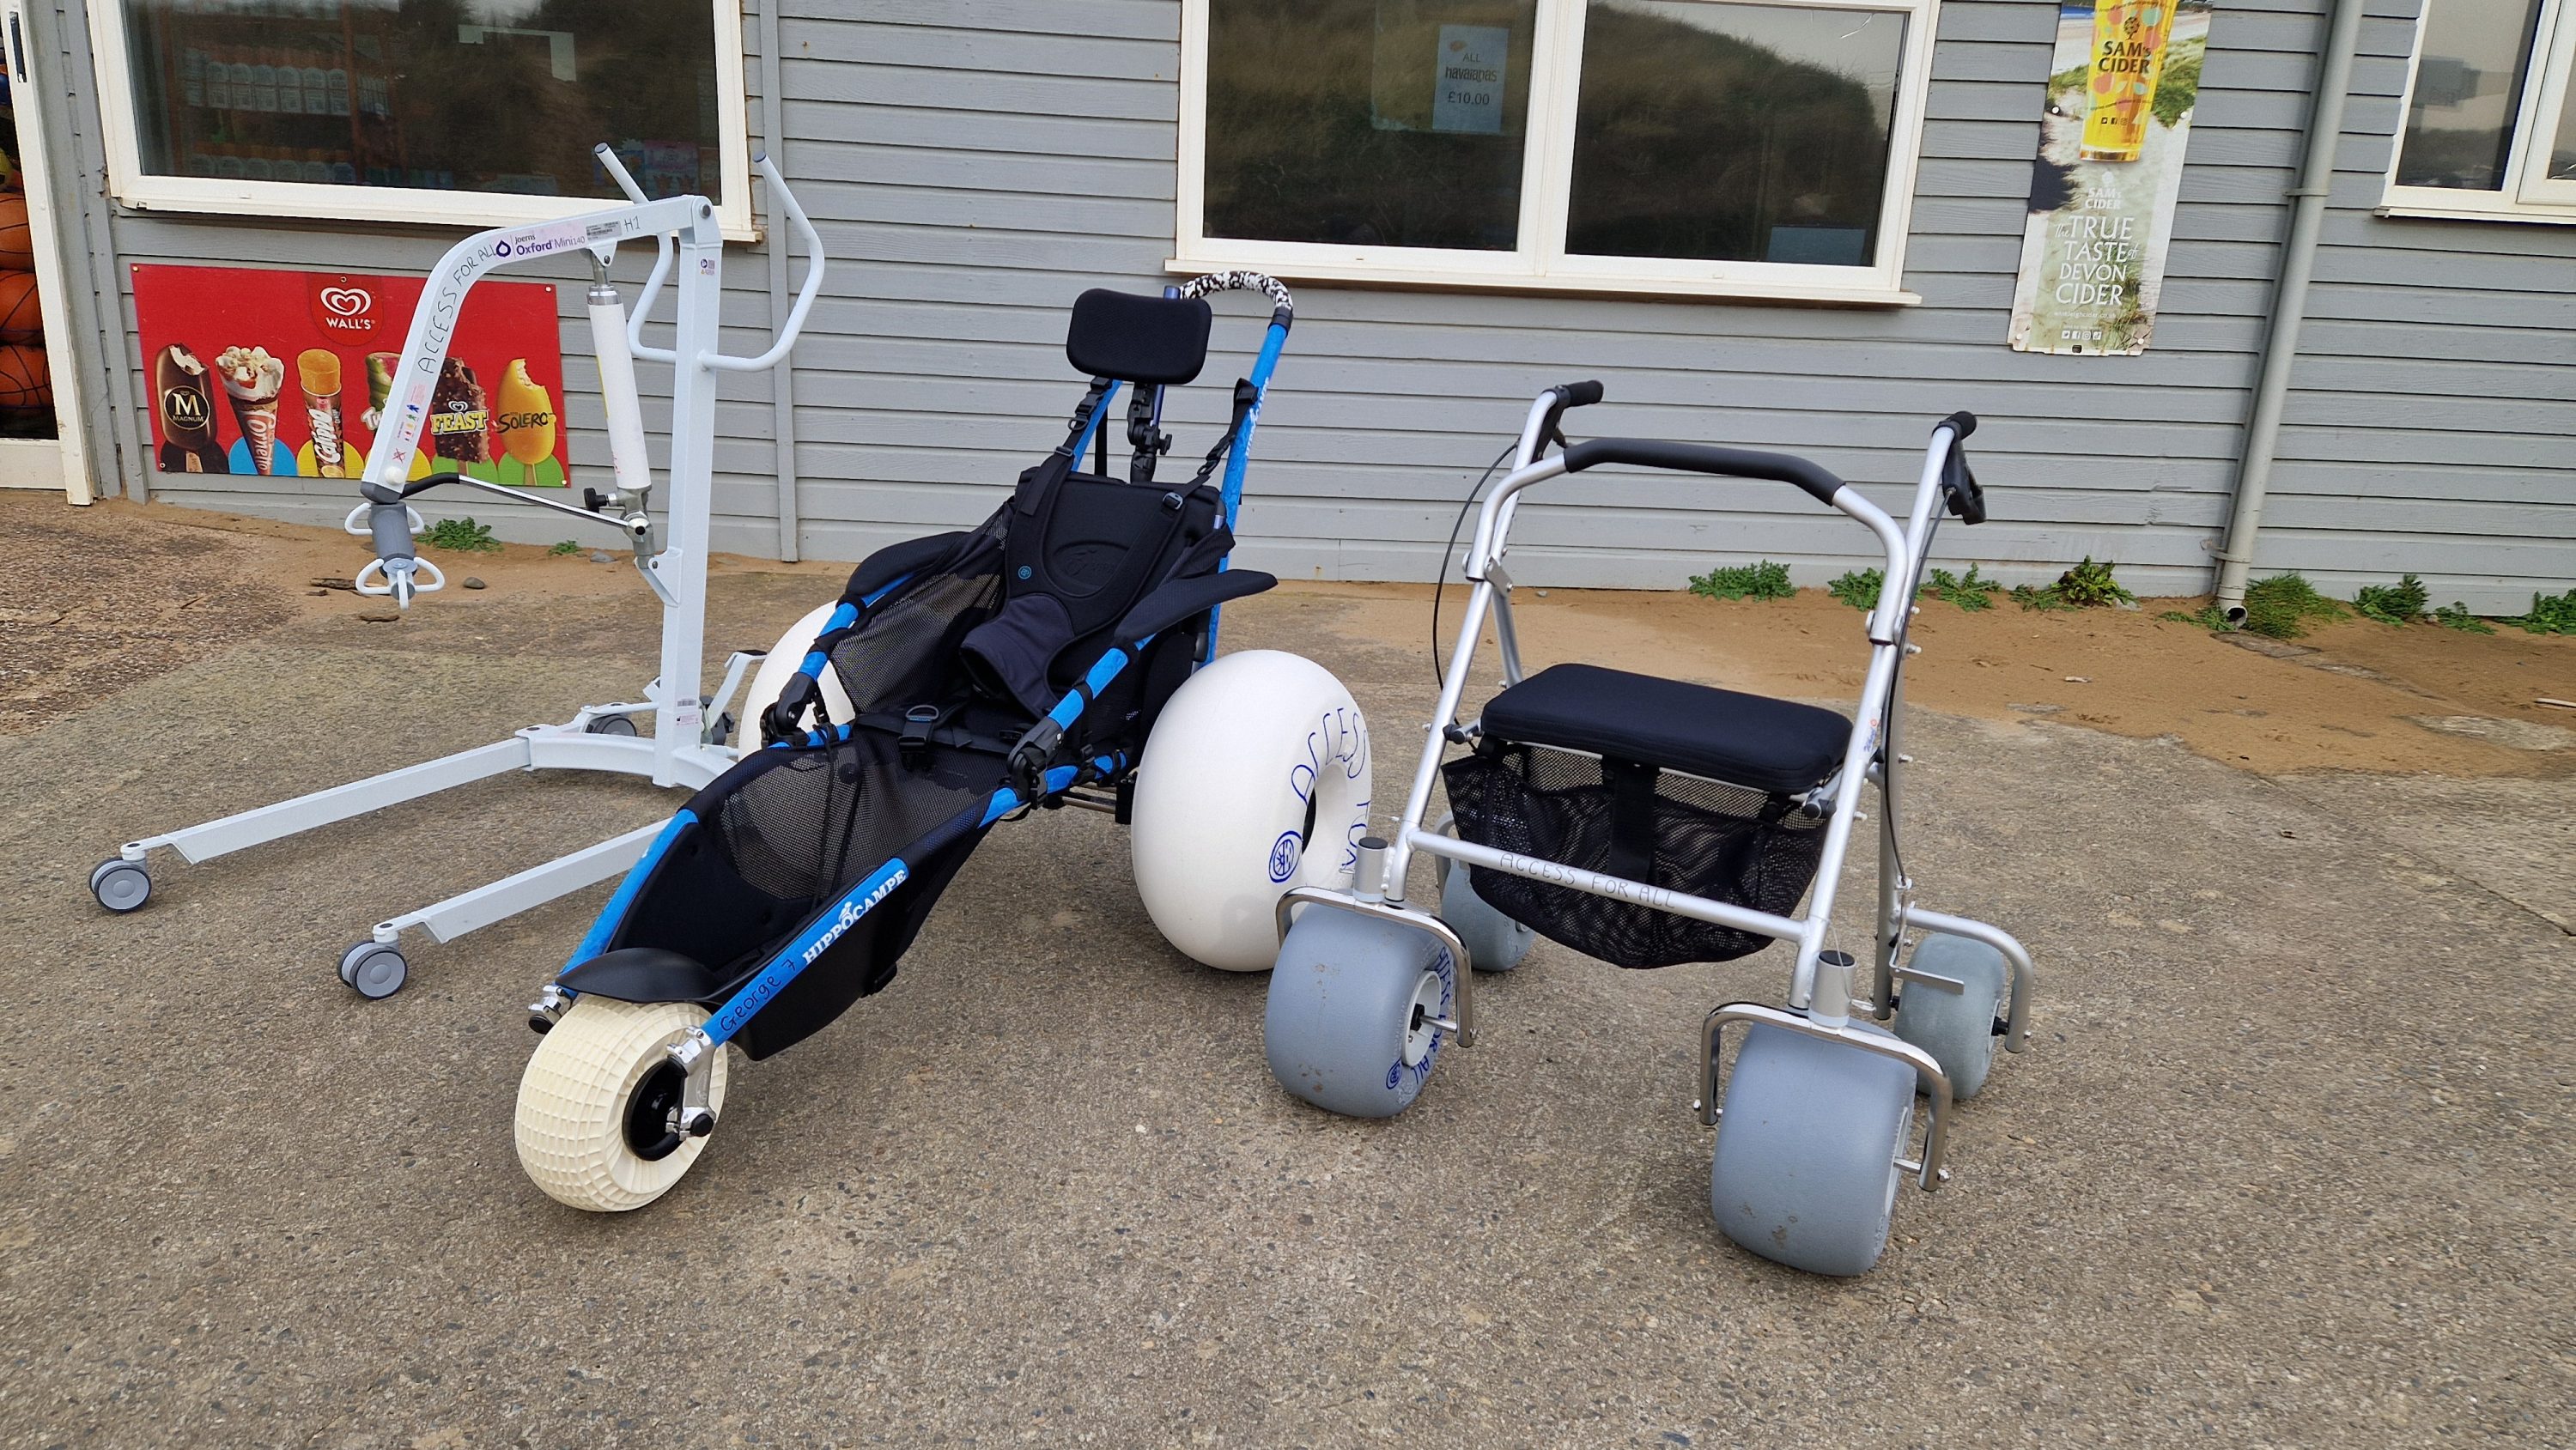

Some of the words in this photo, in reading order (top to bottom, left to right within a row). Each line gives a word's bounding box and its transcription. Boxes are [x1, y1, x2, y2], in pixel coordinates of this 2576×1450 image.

[1462, 53, 1481, 63] ALL
[2098, 58, 2151, 74] CIDER
[1445, 67, 1498, 83] havaianas
[1448, 91, 1490, 106] £10.00
[2085, 198, 2122, 209] CIDER
[515, 233, 536, 245] Joerns
[2069, 215, 2135, 240] TRUE
[516, 240, 553, 256] Oxford
[2064, 240, 2129, 263] TASTE
[2128, 241, 2140, 260] of
[2059, 263, 2127, 282] DEVON
[2056, 282, 2123, 306] CIDER
[417, 288, 458, 373] ACCESS
[453, 257, 479, 287] FOR
[477, 244, 497, 262] ALL
[325, 317, 371, 331] WALL'S
[173, 392, 202, 416] M
[430, 410, 489, 434] FEAST
[246, 410, 276, 471] Cornetto
[307, 409, 341, 464] Calippo
[1499, 852, 1577, 885] ACCESS
[1591, 875, 1629, 898] FOR
[1638, 885, 1674, 909] ALL
[802, 869, 907, 965] HIPPOCAMPE
[720, 974, 781, 1032] George
